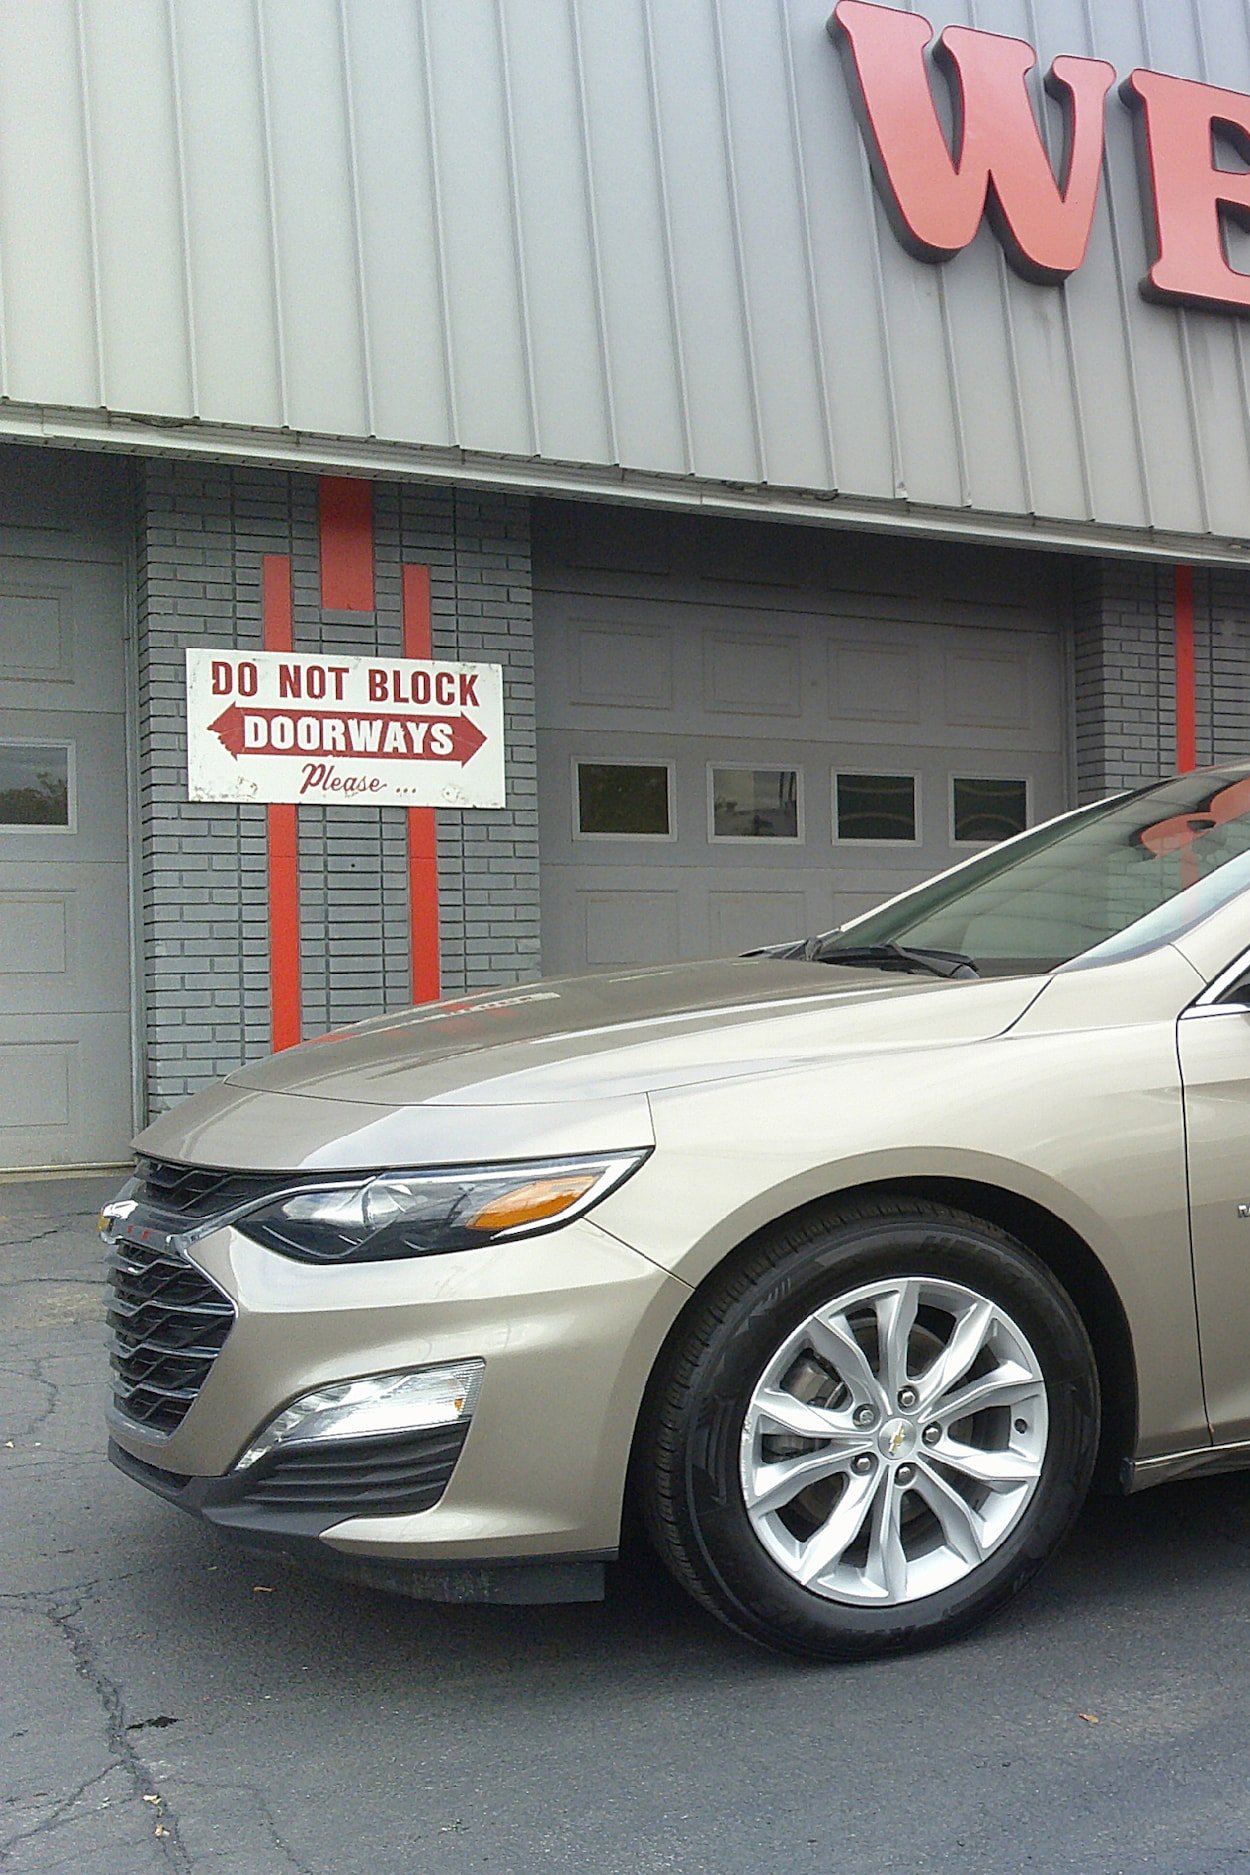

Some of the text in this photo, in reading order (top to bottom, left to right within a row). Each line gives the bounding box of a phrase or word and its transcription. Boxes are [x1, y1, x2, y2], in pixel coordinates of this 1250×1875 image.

[211, 661, 480, 707] DO NOT BLOCK
[243, 714, 454, 756] DOORWAYS
[299, 763, 387, 795] Please
